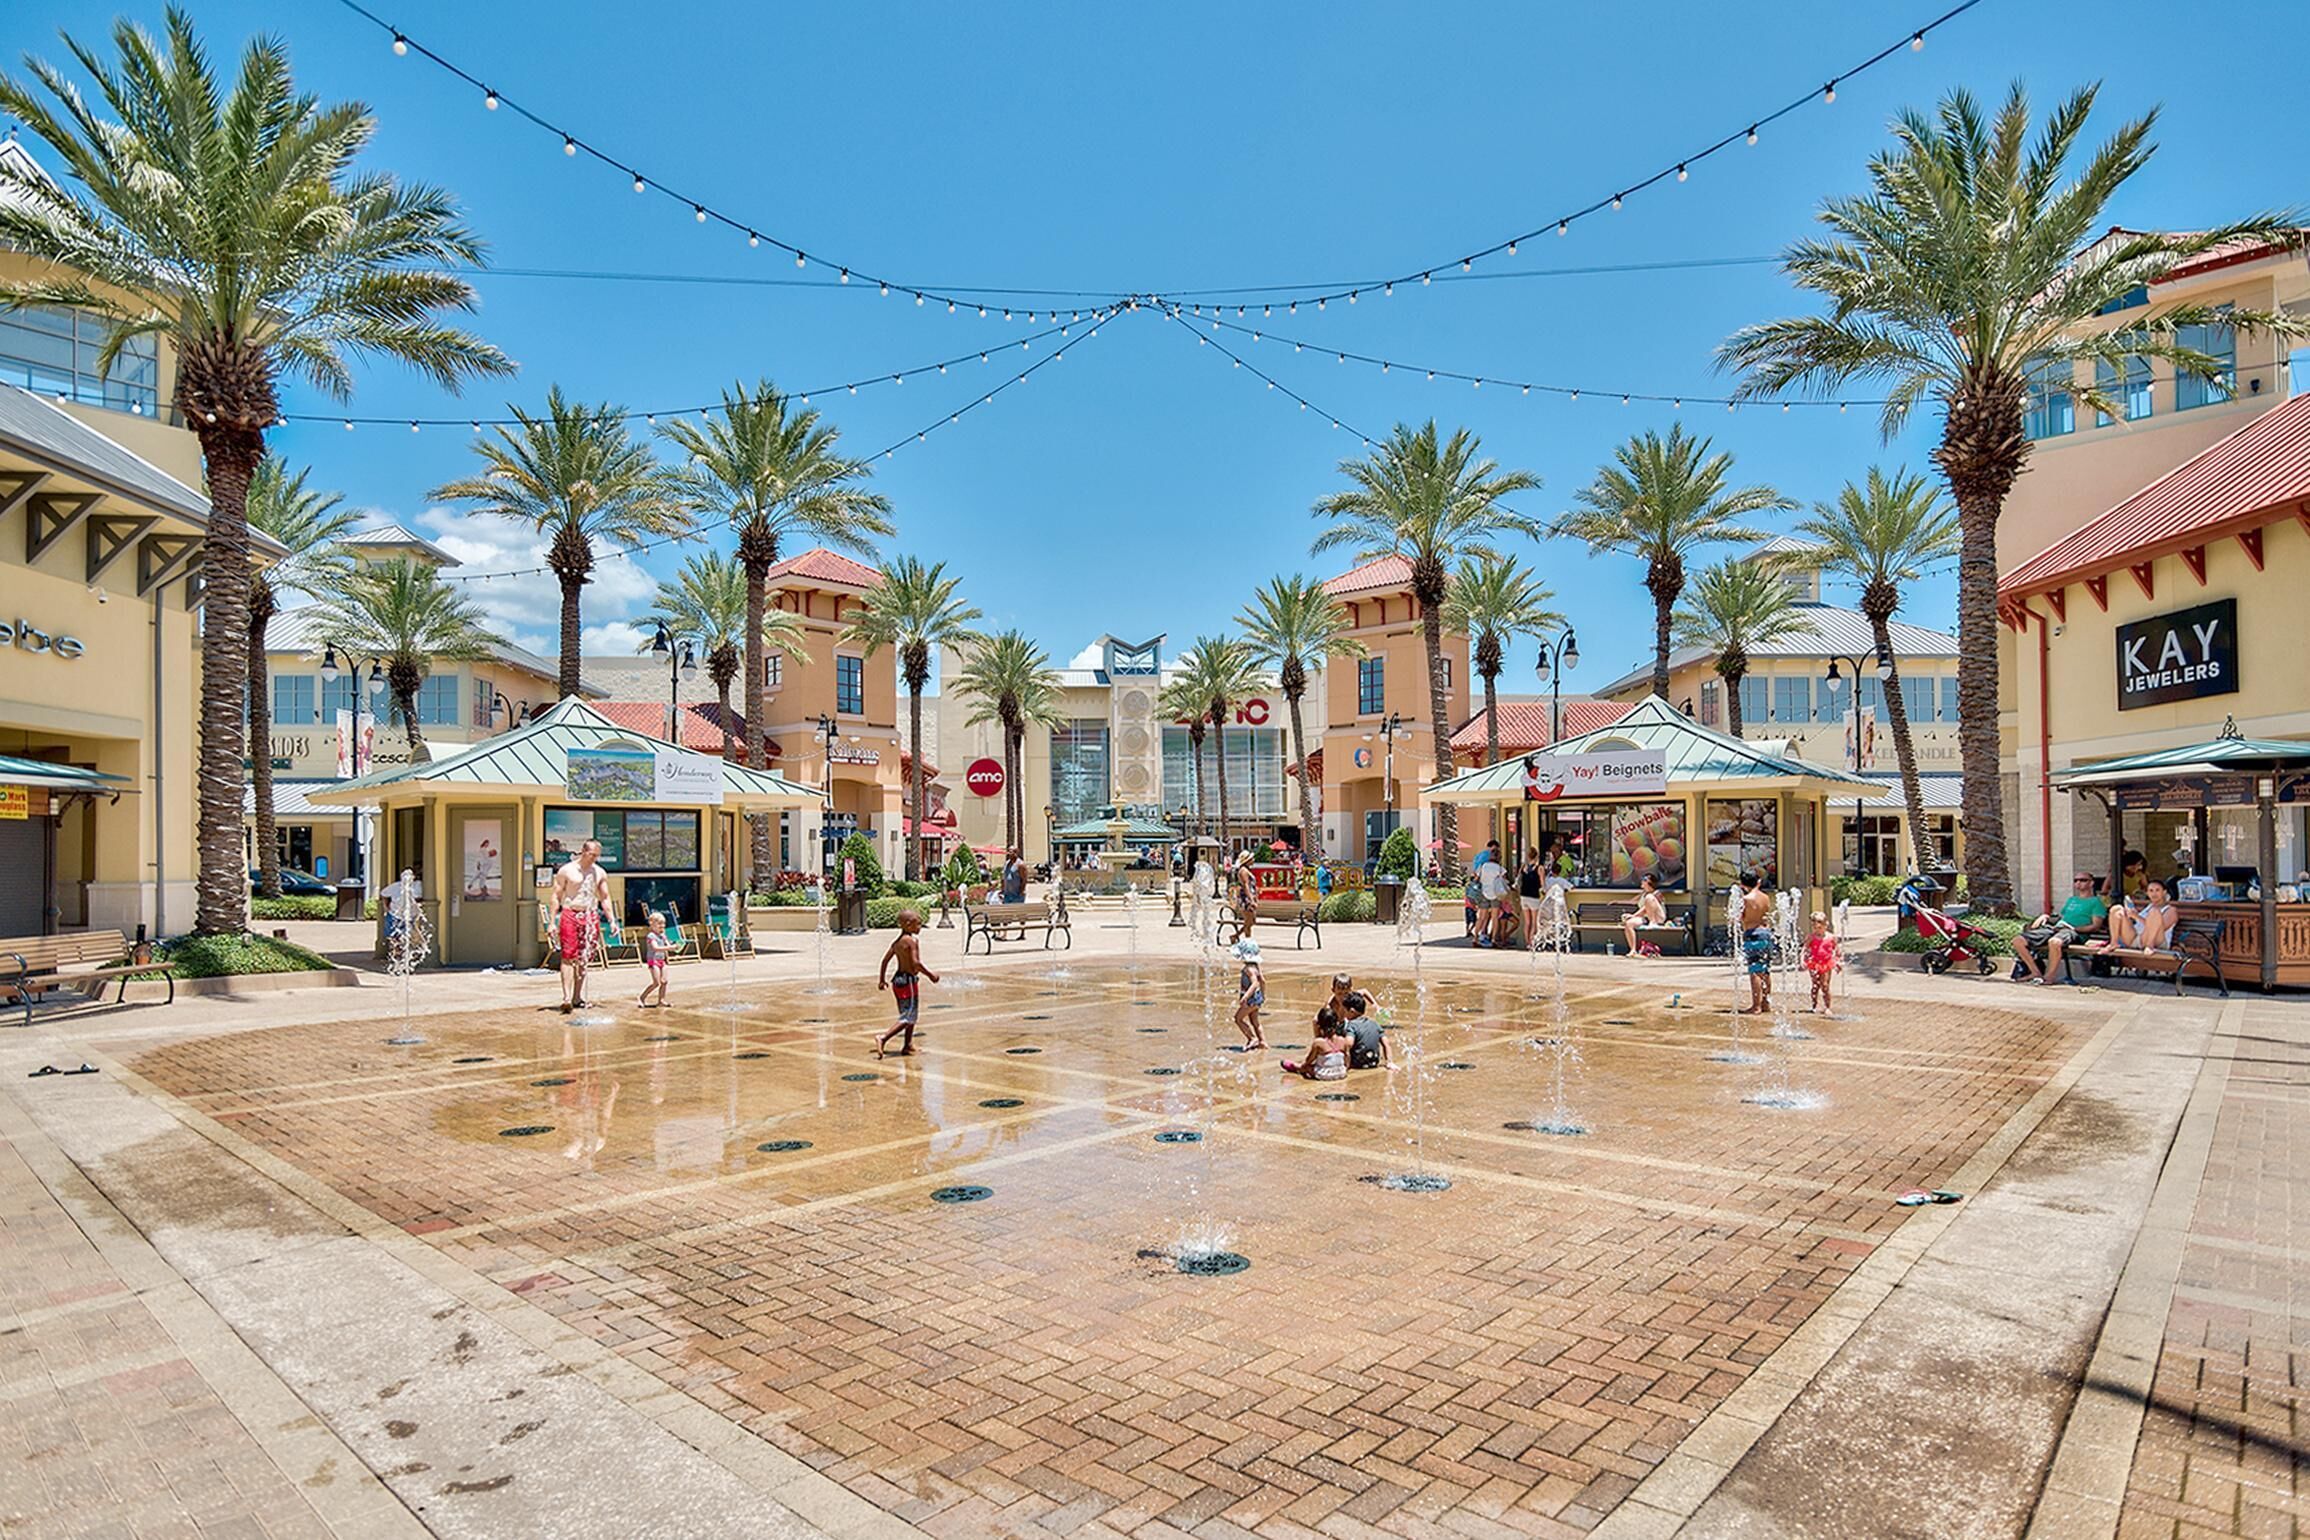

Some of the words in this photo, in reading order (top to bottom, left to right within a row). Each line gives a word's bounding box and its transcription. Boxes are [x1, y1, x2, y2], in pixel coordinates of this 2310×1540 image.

[2124, 619, 2219, 677] KAY
[2125, 661, 2220, 693] JEWELERS
[270, 736, 309, 757] SHOES
[1875, 747, 1898, 760] KEE
[1914, 747, 1957, 760] ANDLE
[969, 772, 1003, 783] amc
[1572, 765, 1599, 780] Yay!
[1602, 763, 1664, 778] Beignets
[1614, 806, 1674, 838] snowballs
